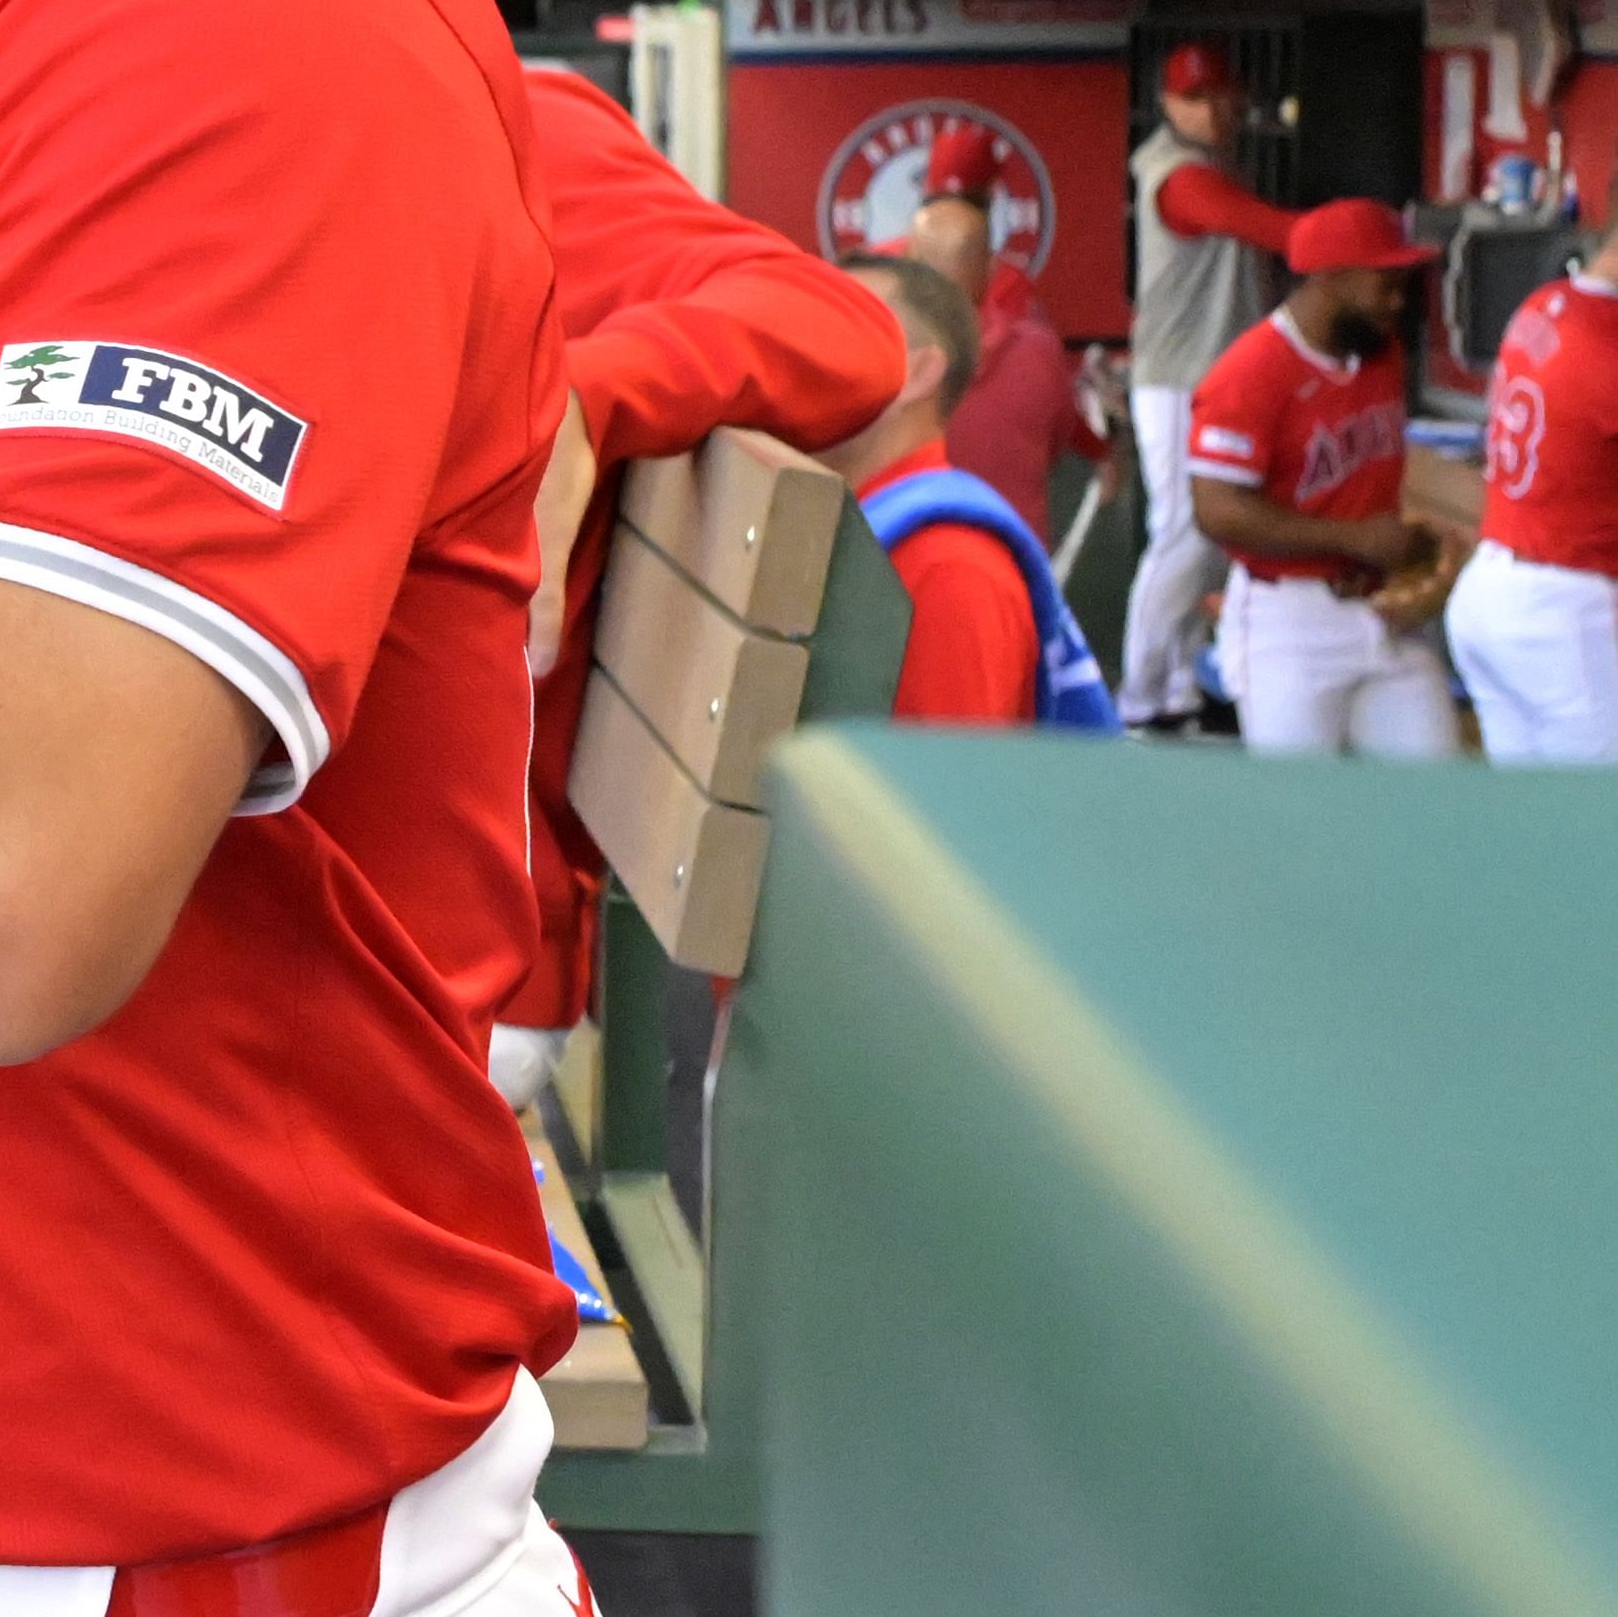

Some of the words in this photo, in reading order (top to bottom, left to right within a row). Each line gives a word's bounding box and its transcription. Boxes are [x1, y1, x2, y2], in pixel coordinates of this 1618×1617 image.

[104, 409, 192, 453] Building
[198, 441, 279, 504] Materials
[111, 357, 274, 464] FBM
